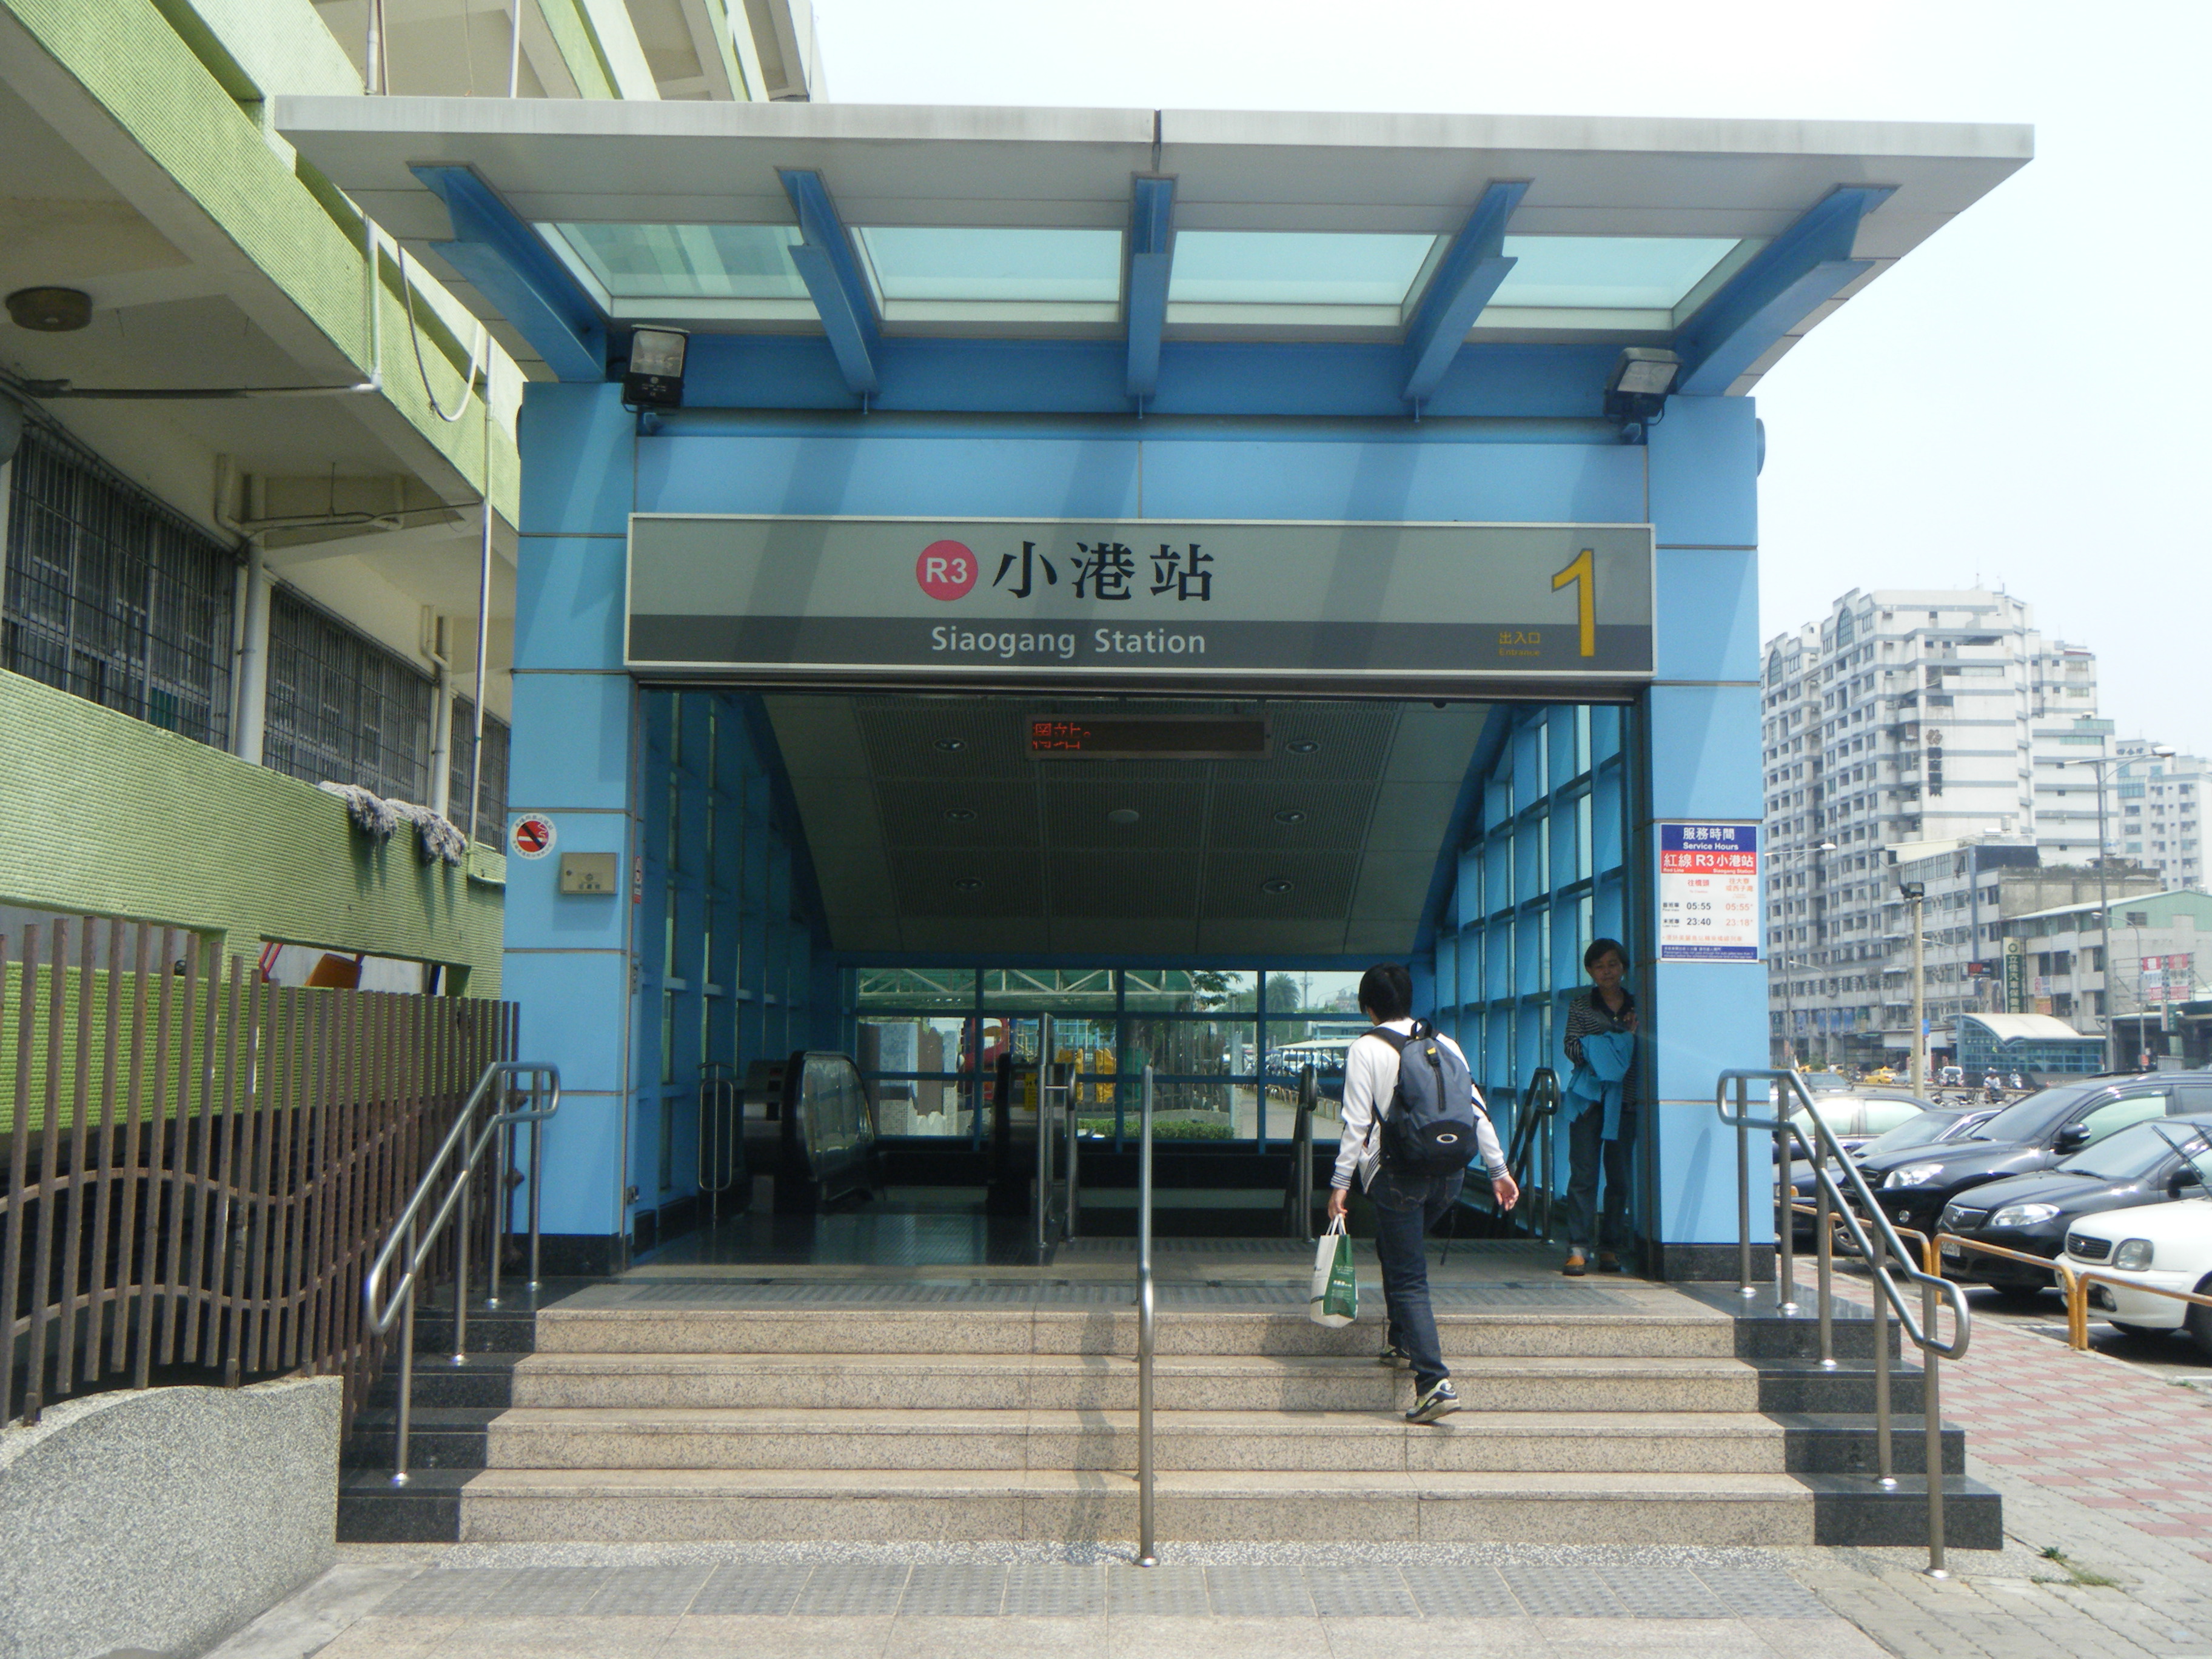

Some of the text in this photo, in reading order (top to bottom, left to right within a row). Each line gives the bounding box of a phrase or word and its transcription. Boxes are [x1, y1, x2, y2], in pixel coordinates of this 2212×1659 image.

[926, 541, 1215, 602] R3 小港站
[1551, 548, 1596, 657] 1
[931, 625, 1205, 659] Siaogang Station
[1498, 631, 1541, 645] 出入口
[1498, 648, 1541, 656] Entrance
[1683, 827, 1735, 840] 服務時間
[1683, 842, 1713, 850] Service
[1663, 853, 1754, 868] 紅線 R3 小港站
[1686, 902, 1711, 910] 05:55
[1687, 917, 1711, 926] 23:40
